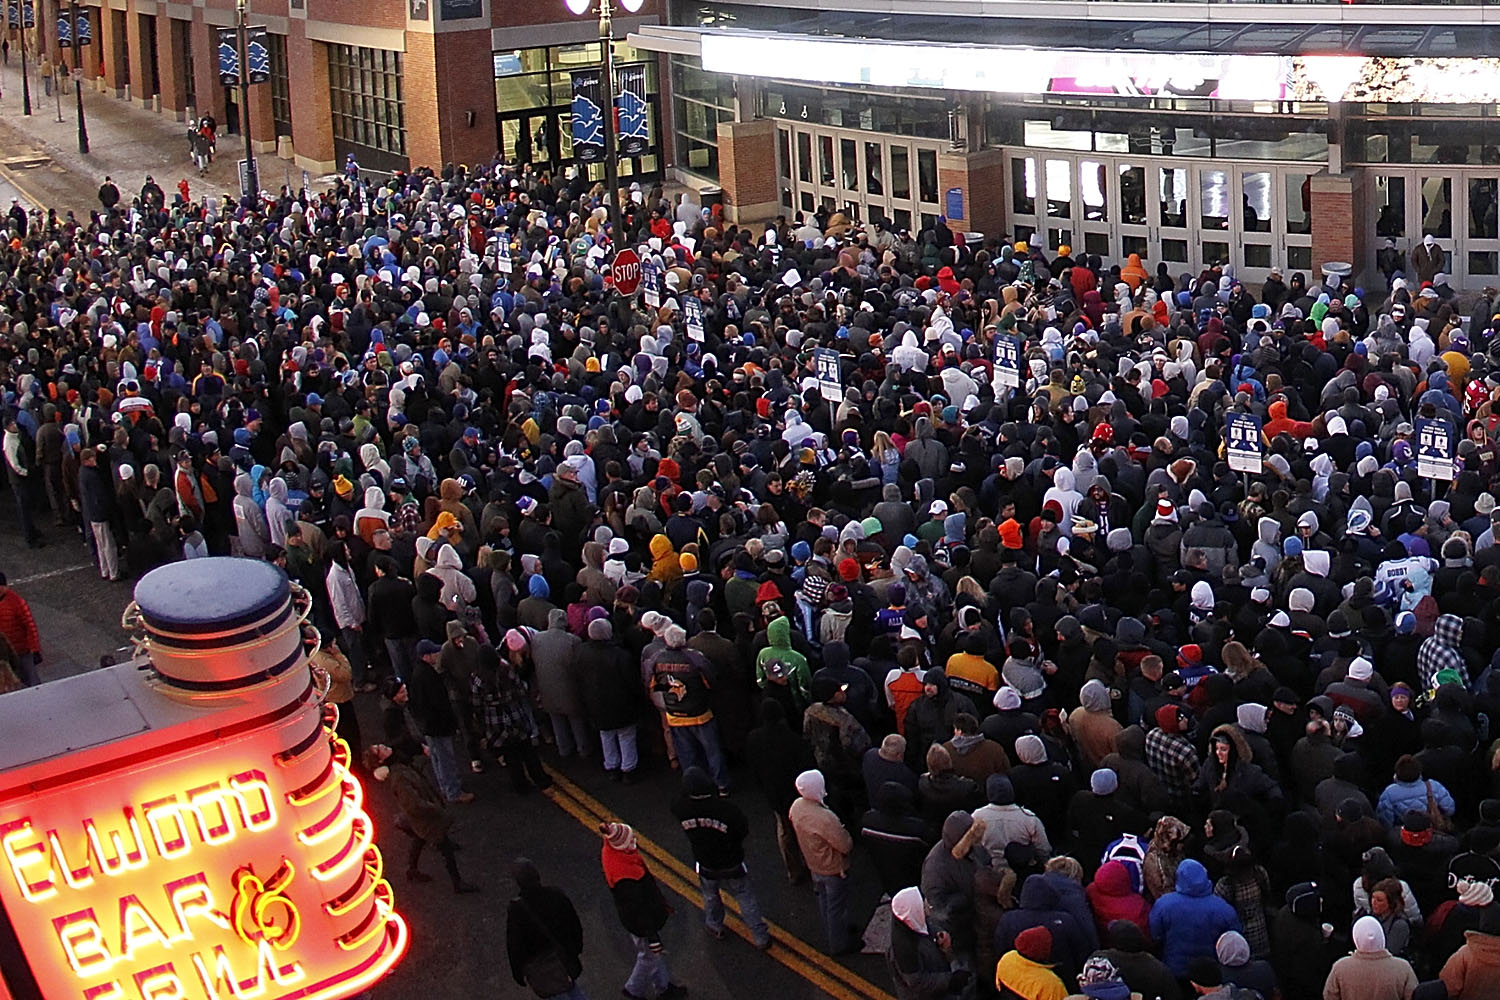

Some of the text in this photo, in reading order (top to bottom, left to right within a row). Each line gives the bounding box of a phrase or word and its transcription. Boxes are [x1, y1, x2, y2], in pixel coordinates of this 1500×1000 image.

[614, 262, 639, 283] STOP
[1387, 567, 1408, 578] BOBBY
[2, 769, 277, 903] ELWOOD
[52, 871, 231, 978] BAR
